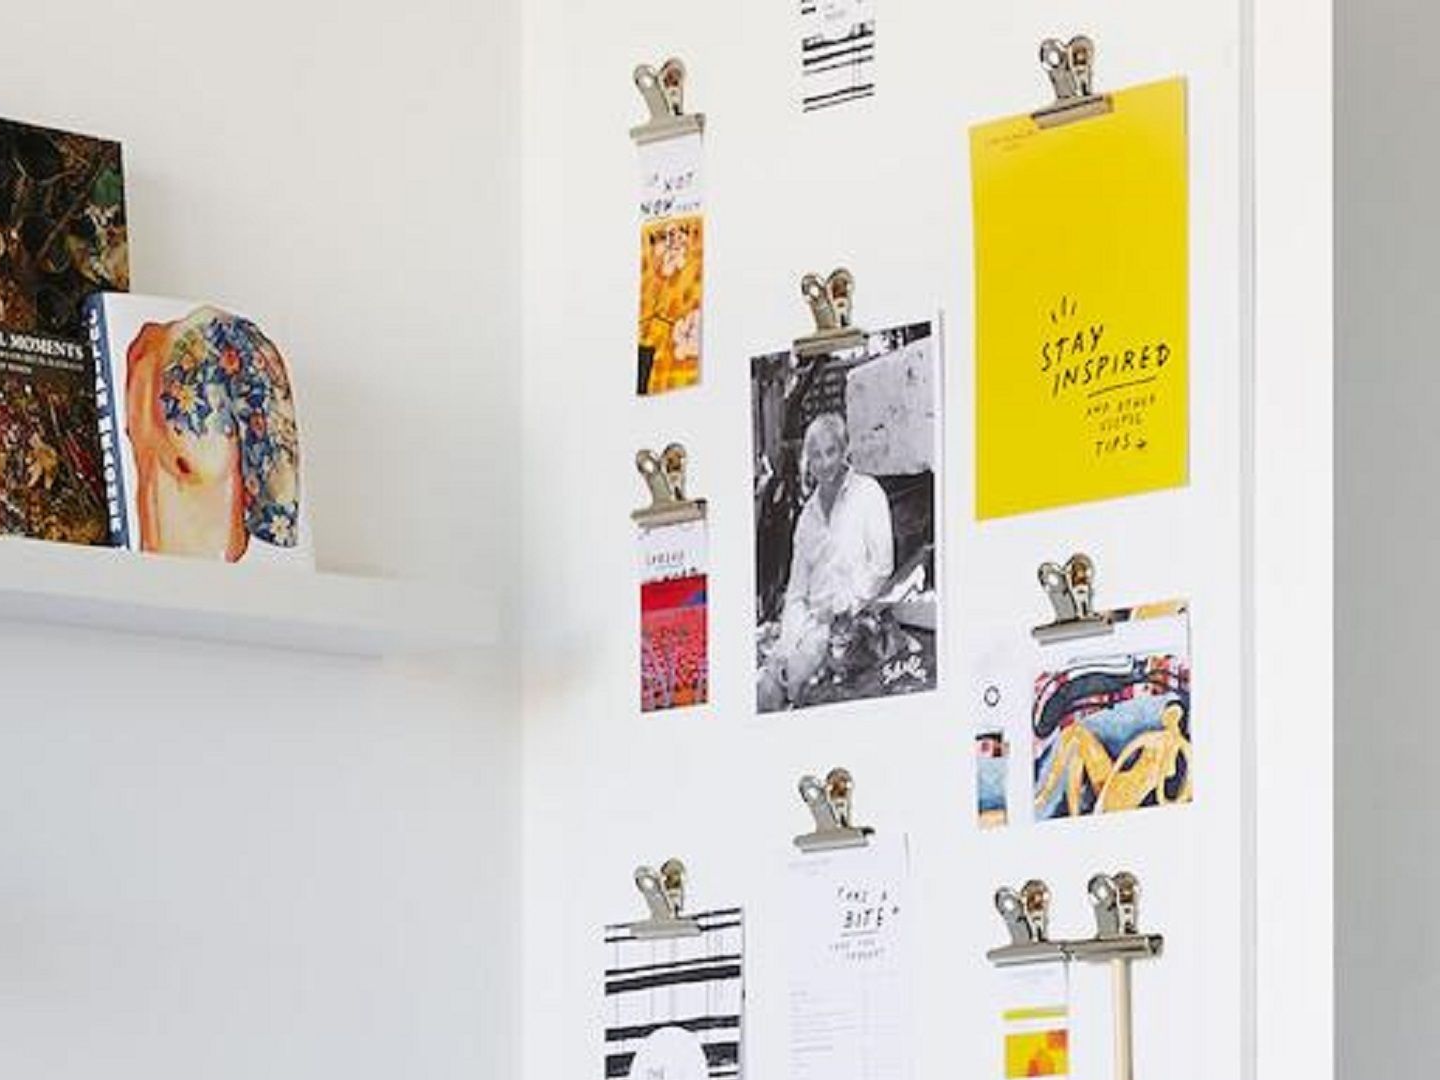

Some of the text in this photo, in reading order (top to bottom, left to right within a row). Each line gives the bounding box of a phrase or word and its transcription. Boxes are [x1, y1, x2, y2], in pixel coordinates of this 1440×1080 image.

[9, 333, 85, 361] MOMENTS
[89, 308, 109, 409] JULIAN
[1041, 324, 1105, 372] STAY
[1051, 342, 1172, 398] INSPIRED
[1095, 432, 1132, 459] TIPS
